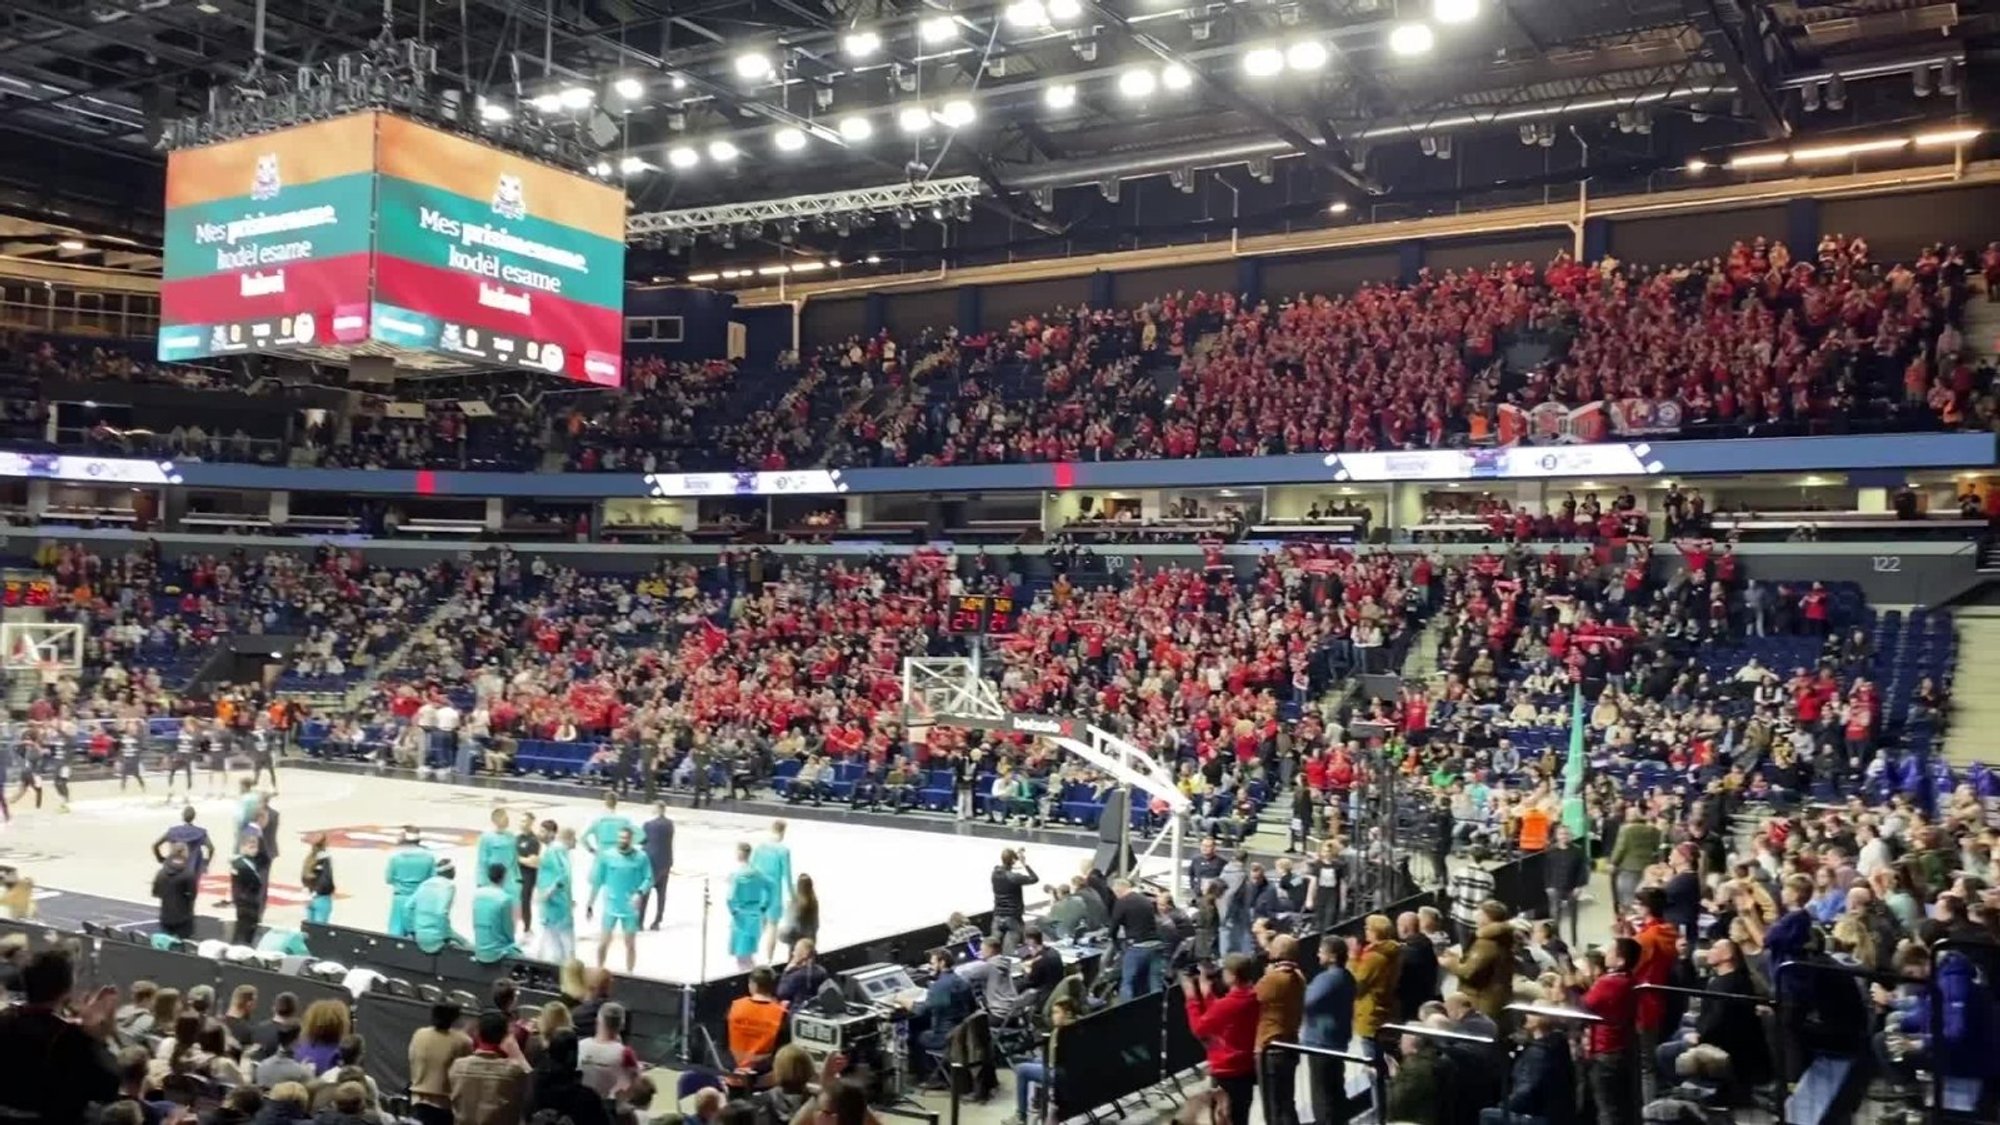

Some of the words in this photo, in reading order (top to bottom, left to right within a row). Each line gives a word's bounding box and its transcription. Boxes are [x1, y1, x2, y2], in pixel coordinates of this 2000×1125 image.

[195, 222, 227, 244] Mes
[420, 207, 460, 237] Mes
[259, 240, 313, 263] esame
[448, 244, 499, 278] kodėl
[502, 265, 562, 293] esame
[1872, 556, 1901, 572] 122
[1013, 716, 1061, 733] betsafe
